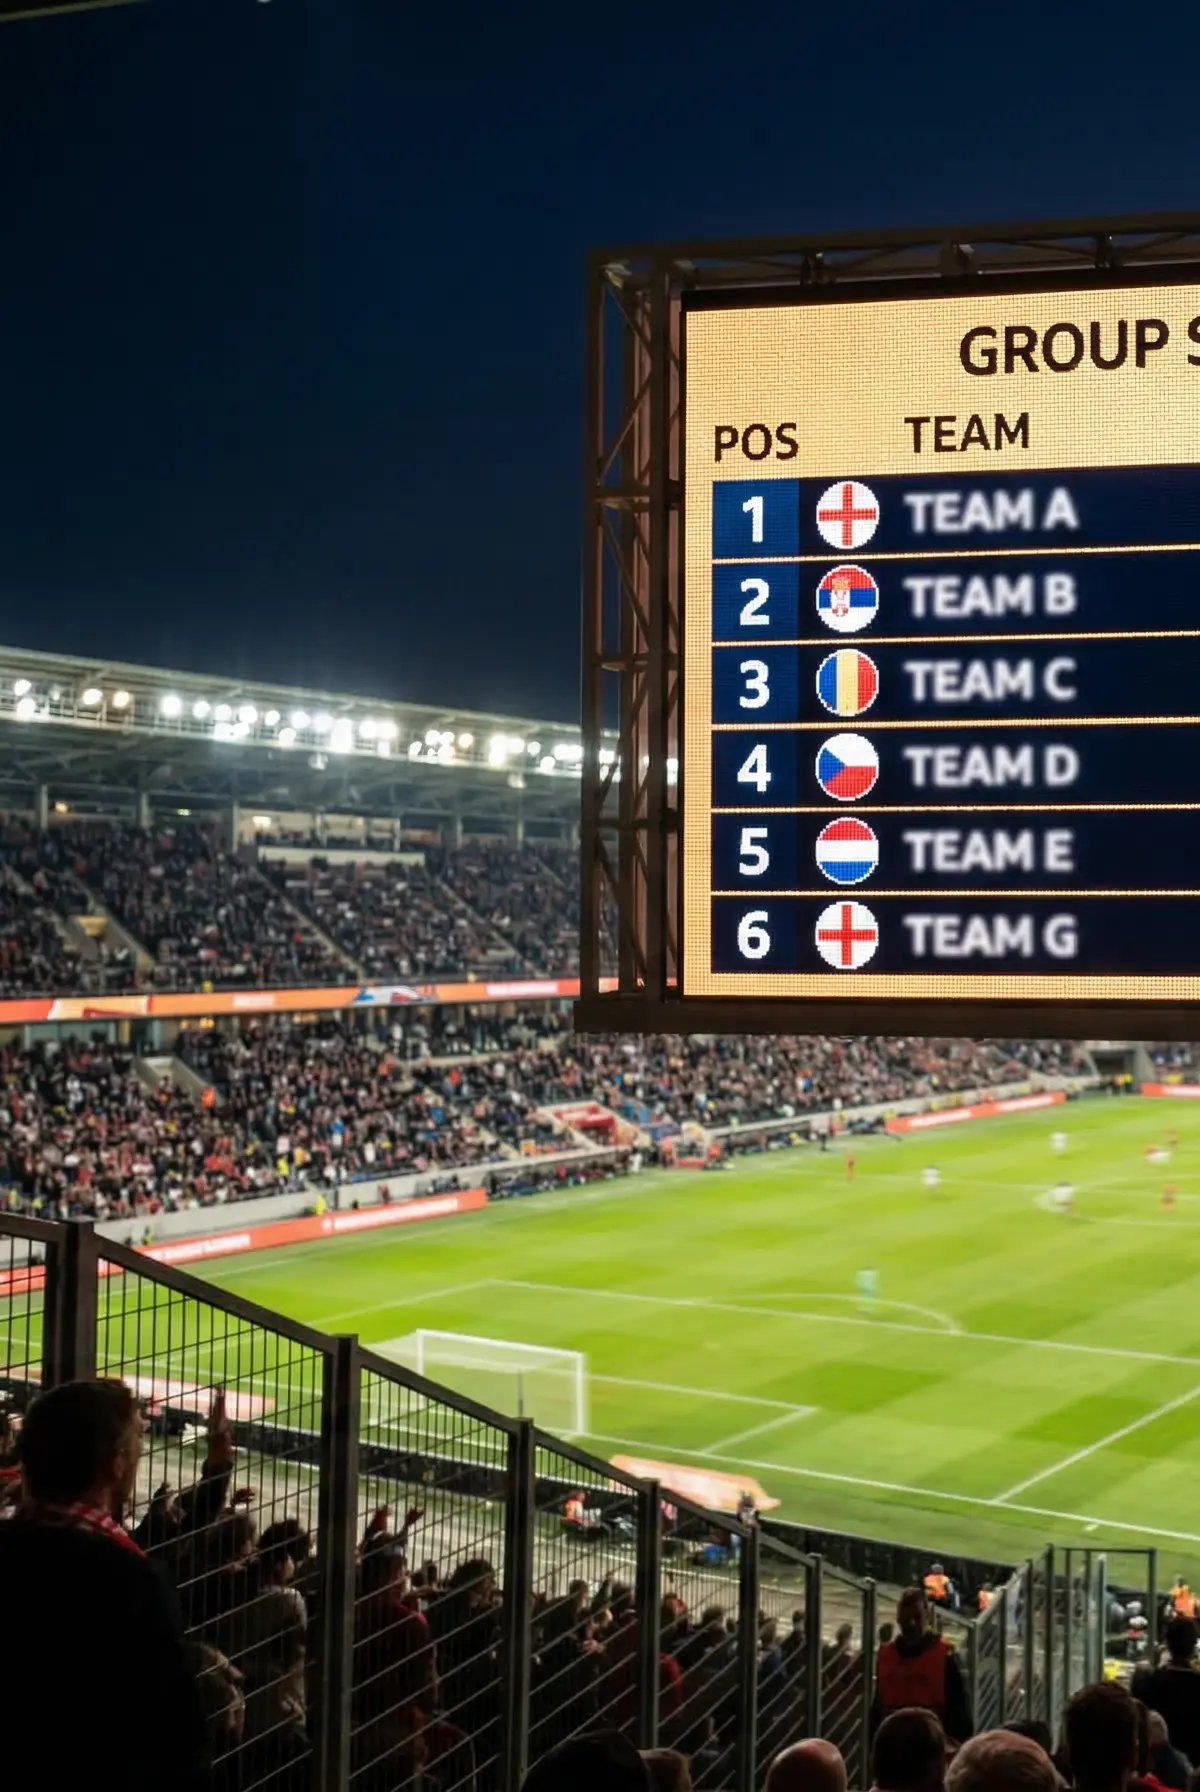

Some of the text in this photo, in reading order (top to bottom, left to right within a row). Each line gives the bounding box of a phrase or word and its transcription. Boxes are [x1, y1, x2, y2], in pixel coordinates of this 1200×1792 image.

[959, 318, 1170, 376] GROUP
[714, 422, 799, 462] POS
[904, 412, 1029, 454] TEAM
[742, 495, 764, 544] 1
[903, 488, 1034, 533] TEAM
[1043, 487, 1079, 530] A
[739, 577, 770, 626] 2
[903, 574, 1034, 618] TEAM
[1044, 572, 1077, 615] B
[739, 659, 771, 709] 3
[903, 659, 1034, 702] TEAM
[1043, 657, 1076, 701] C
[736, 743, 772, 793] 4
[903, 744, 1034, 787] TEAM
[1044, 744, 1079, 786] D
[738, 827, 770, 876] 5
[903, 829, 1034, 872] TEAM
[1044, 829, 1074, 872] E
[736, 909, 772, 960] 6
[903, 914, 1034, 957] TEAM
[1043, 914, 1078, 958] G
